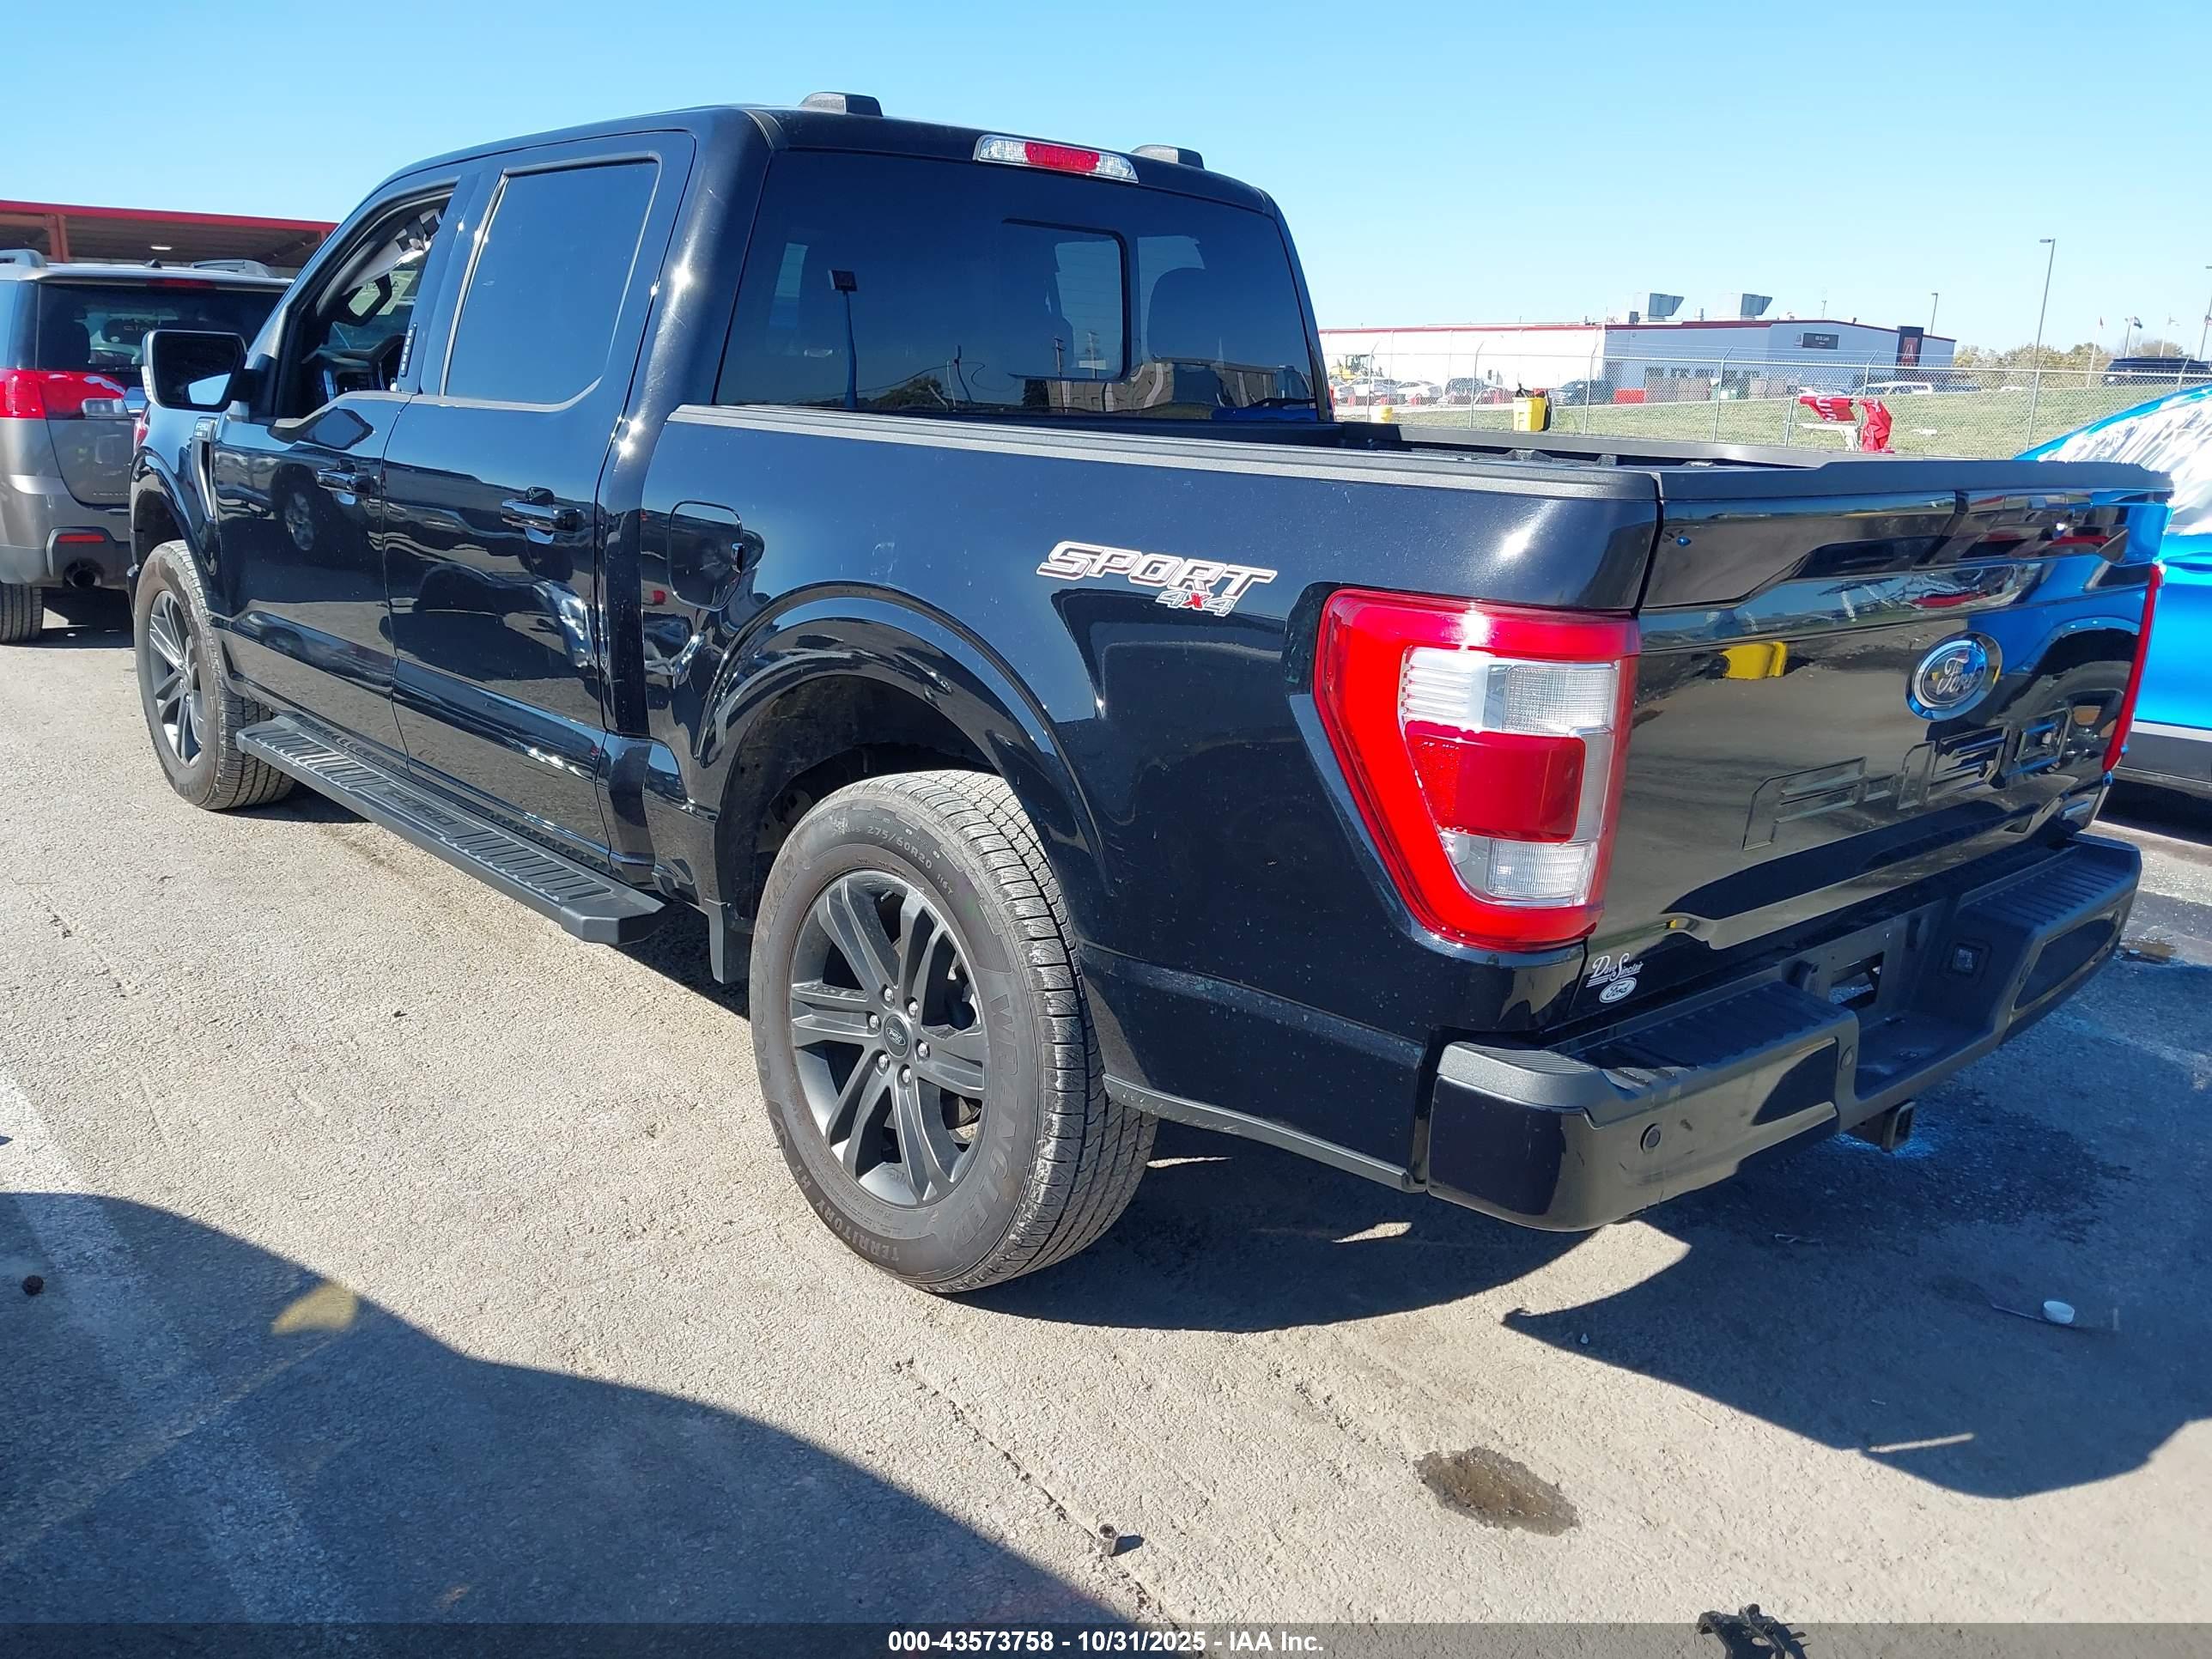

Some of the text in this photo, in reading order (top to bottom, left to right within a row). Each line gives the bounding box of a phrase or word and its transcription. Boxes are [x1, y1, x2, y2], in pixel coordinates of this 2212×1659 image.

[1035, 539, 1279, 599] SPORT
[1936, 656, 1978, 696] Ford
[867, 824, 933, 870] 275/60R20
[1605, 982, 1632, 999] Ford
[888, 1028, 902, 1044] Ford
[815, 1198, 901, 1261] TERRITORY
